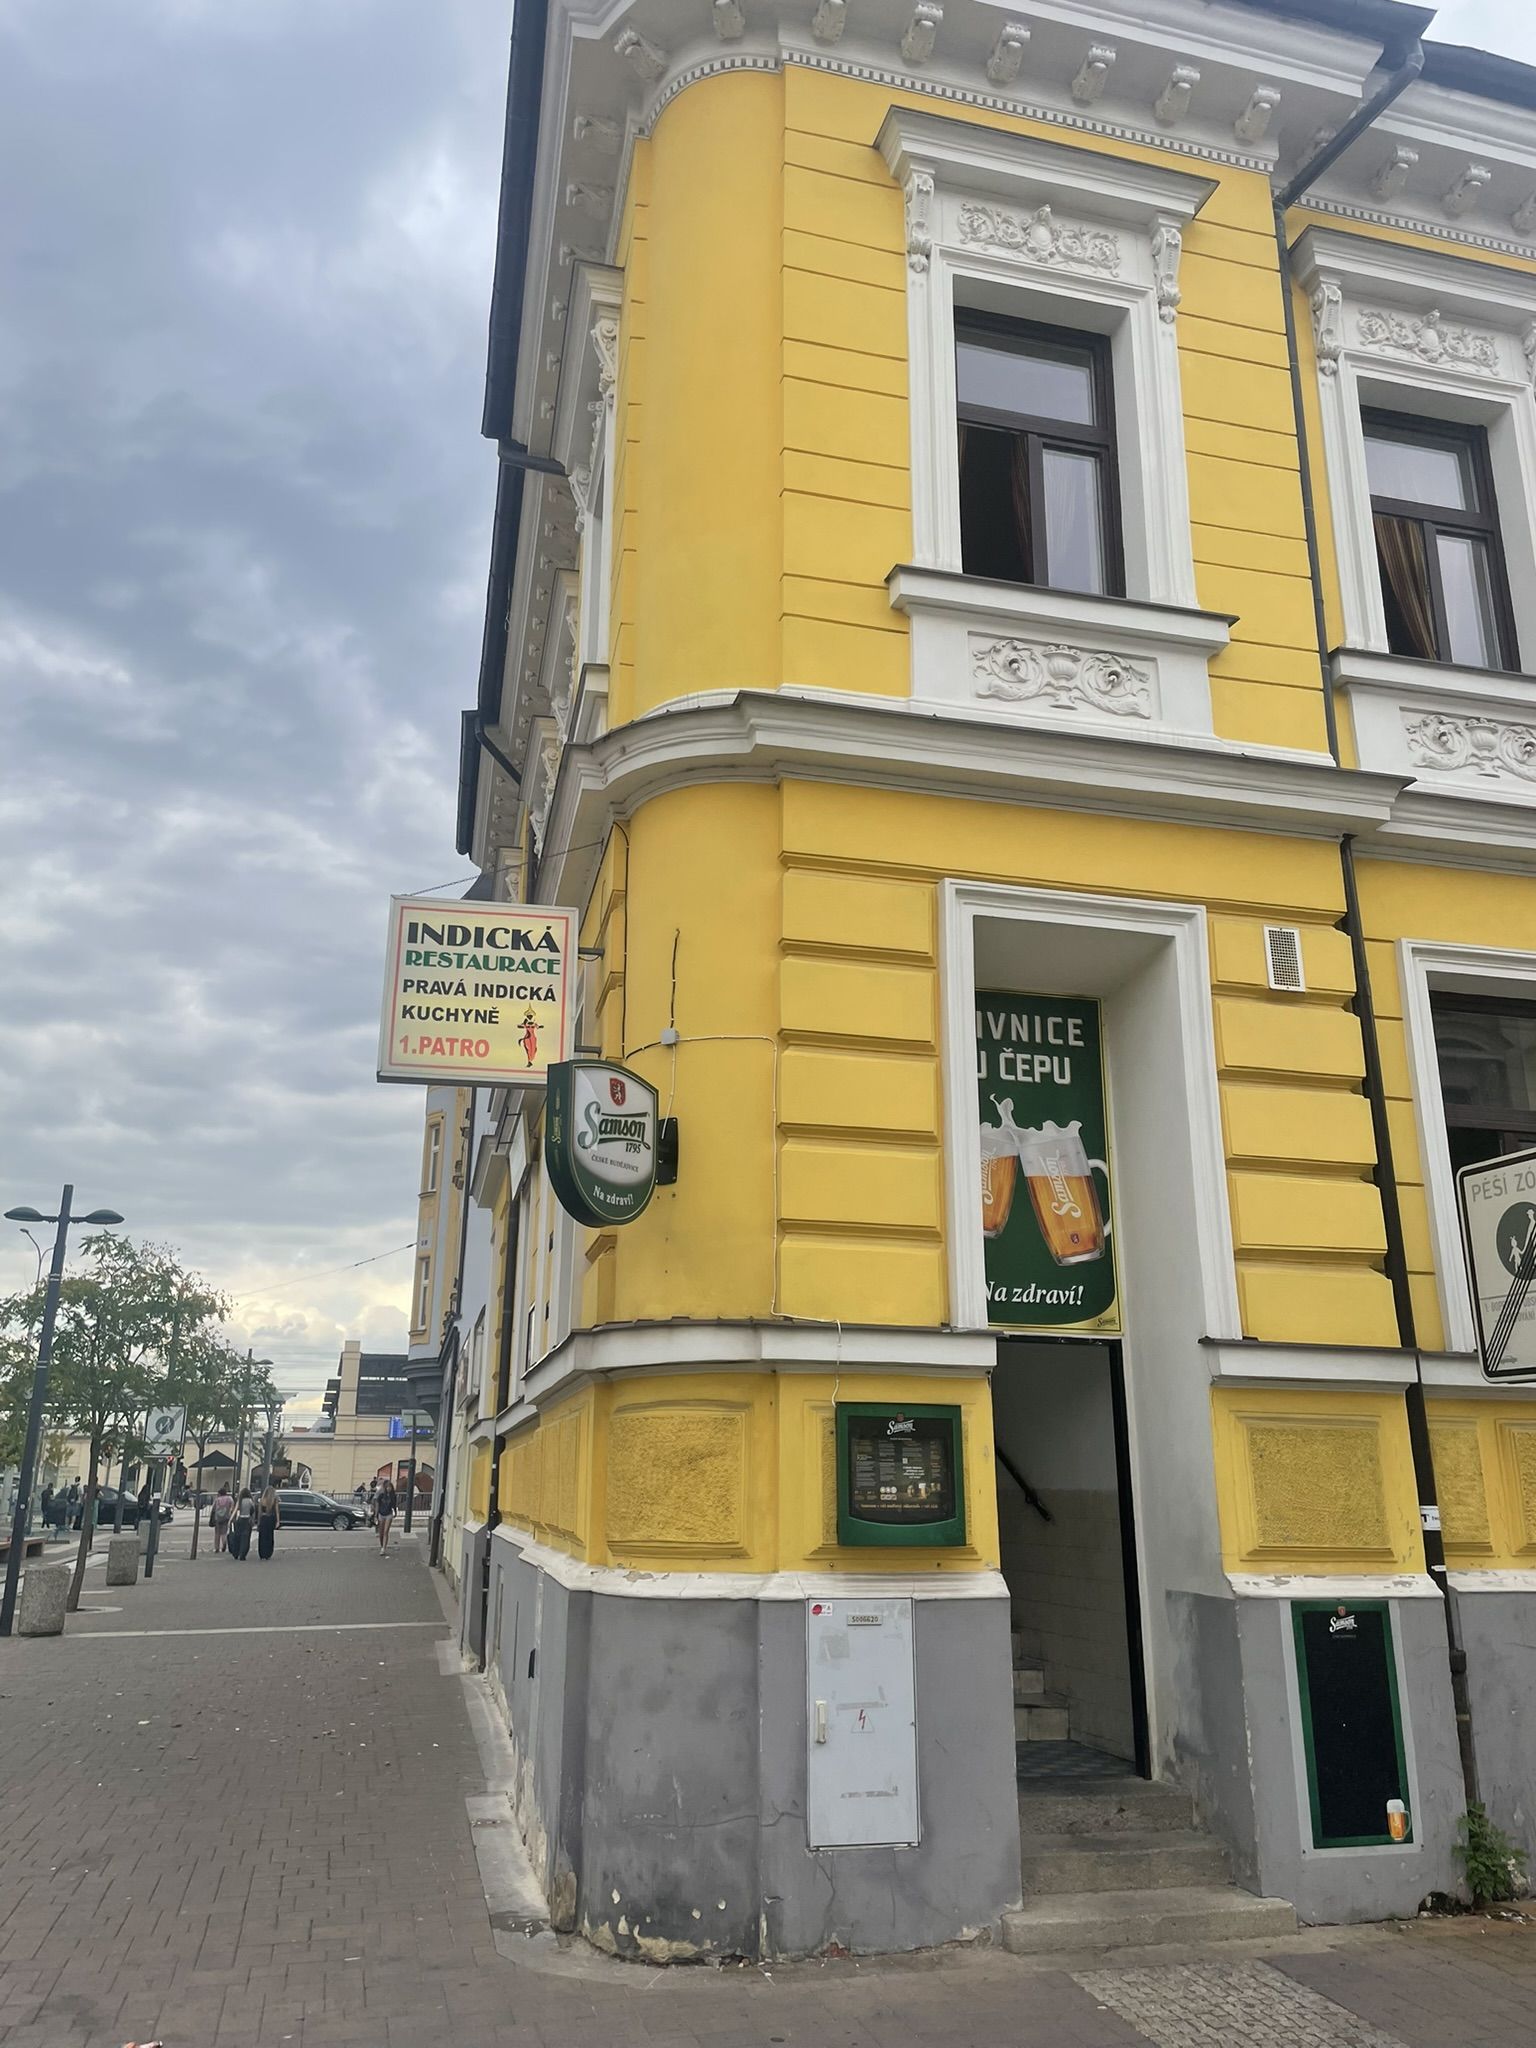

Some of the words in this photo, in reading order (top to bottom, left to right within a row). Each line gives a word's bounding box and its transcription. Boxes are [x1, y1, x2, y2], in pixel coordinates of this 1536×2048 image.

[407, 922, 561, 953] INDICKÁ
[405, 950, 561, 975] RESTAURACE
[402, 978, 467, 997] PRAVÁ
[474, 983, 556, 1002] INDICKÁ
[401, 1004, 500, 1025] KUCHYNĚ
[399, 1035, 490, 1058] 1.PATRO
[999, 1047, 1072, 1085] ČEPU
[577, 1100, 651, 1149] Samson
[625, 1142, 642, 1154] 1795
[592, 1185, 605, 1201] Na
[606, 1193, 635, 1206] zdraví!
[1011, 1283, 1084, 1306] zdraví!
